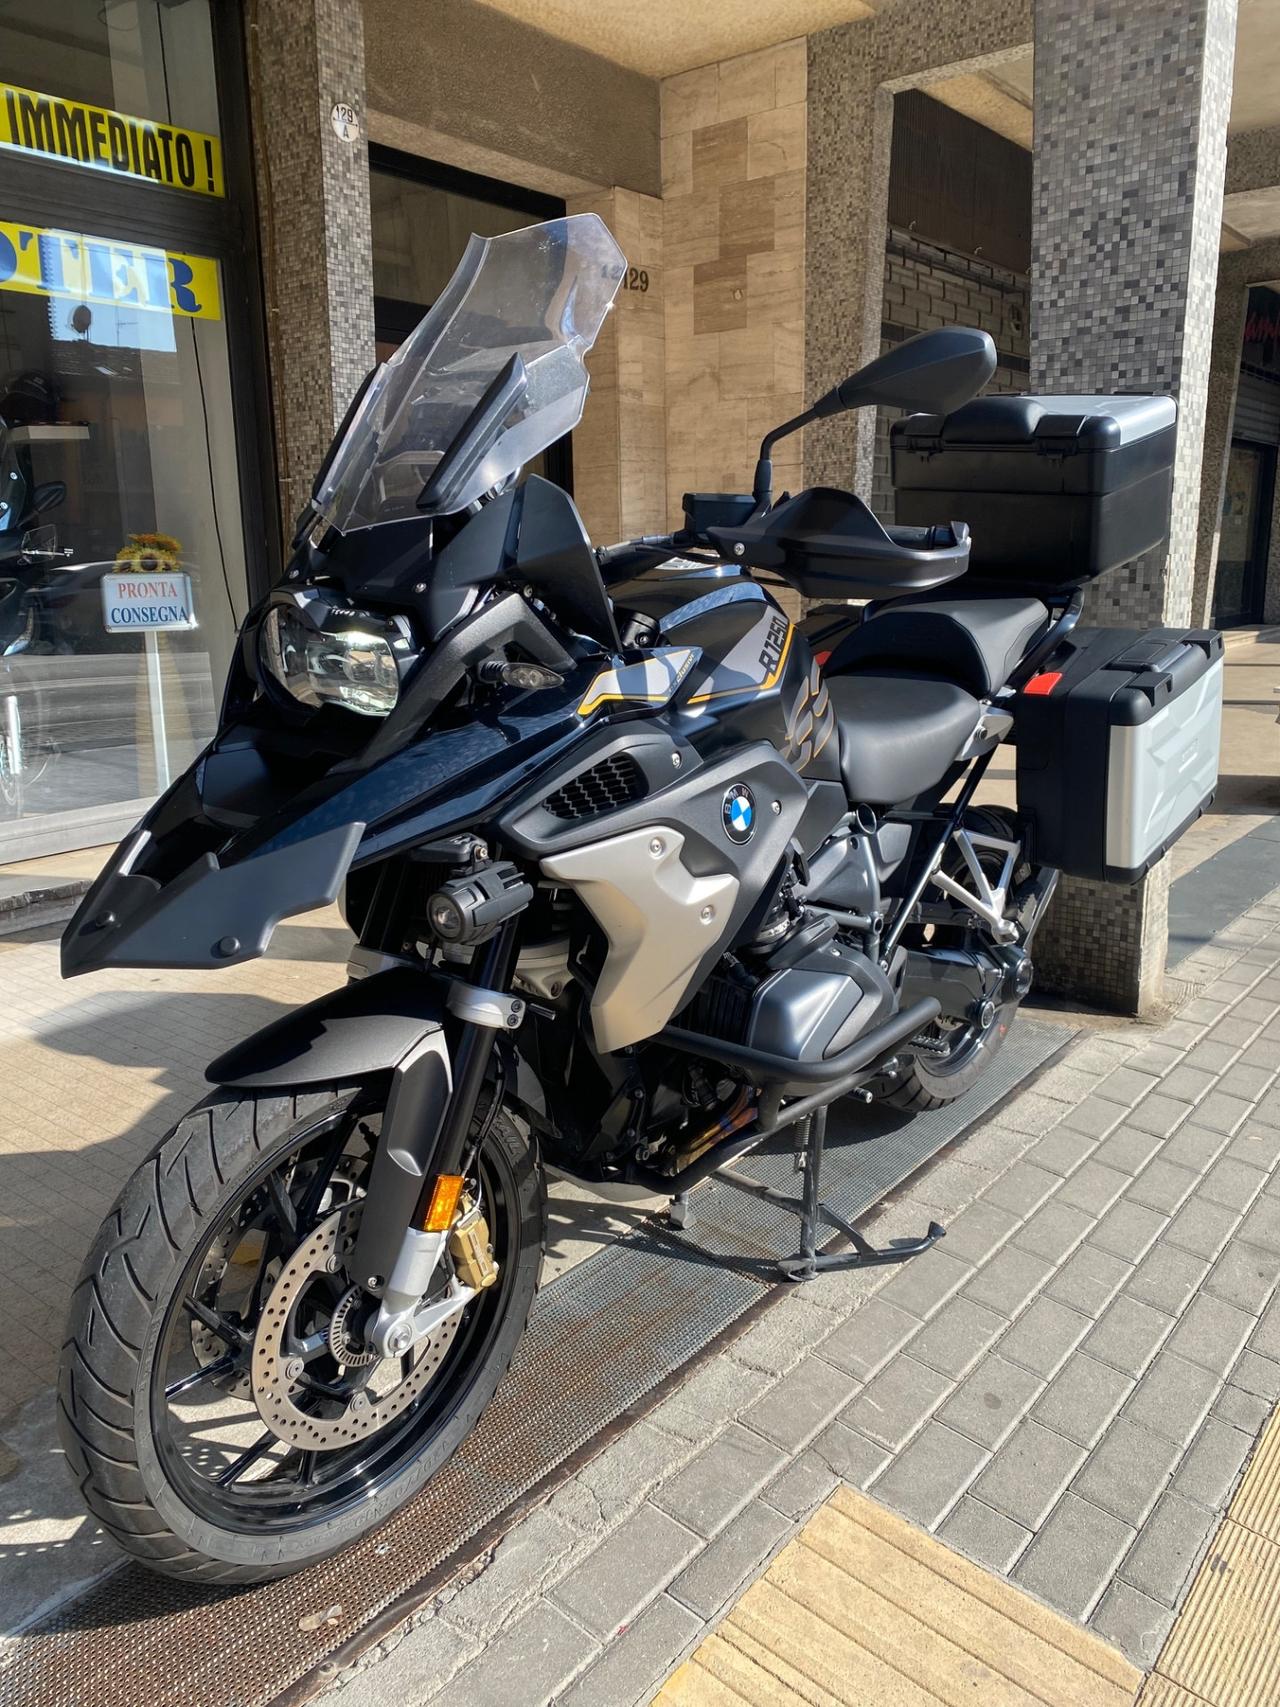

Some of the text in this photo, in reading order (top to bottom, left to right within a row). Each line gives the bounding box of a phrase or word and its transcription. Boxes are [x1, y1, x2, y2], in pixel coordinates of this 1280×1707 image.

[336, 105, 353, 123] 129
[5, 89, 195, 187] IMMEDIATO
[343, 124, 350, 139] A
[0, 230, 202, 313] TER
[118, 581, 178, 599] PRONTA
[111, 606, 188, 624] CONSEGNA
